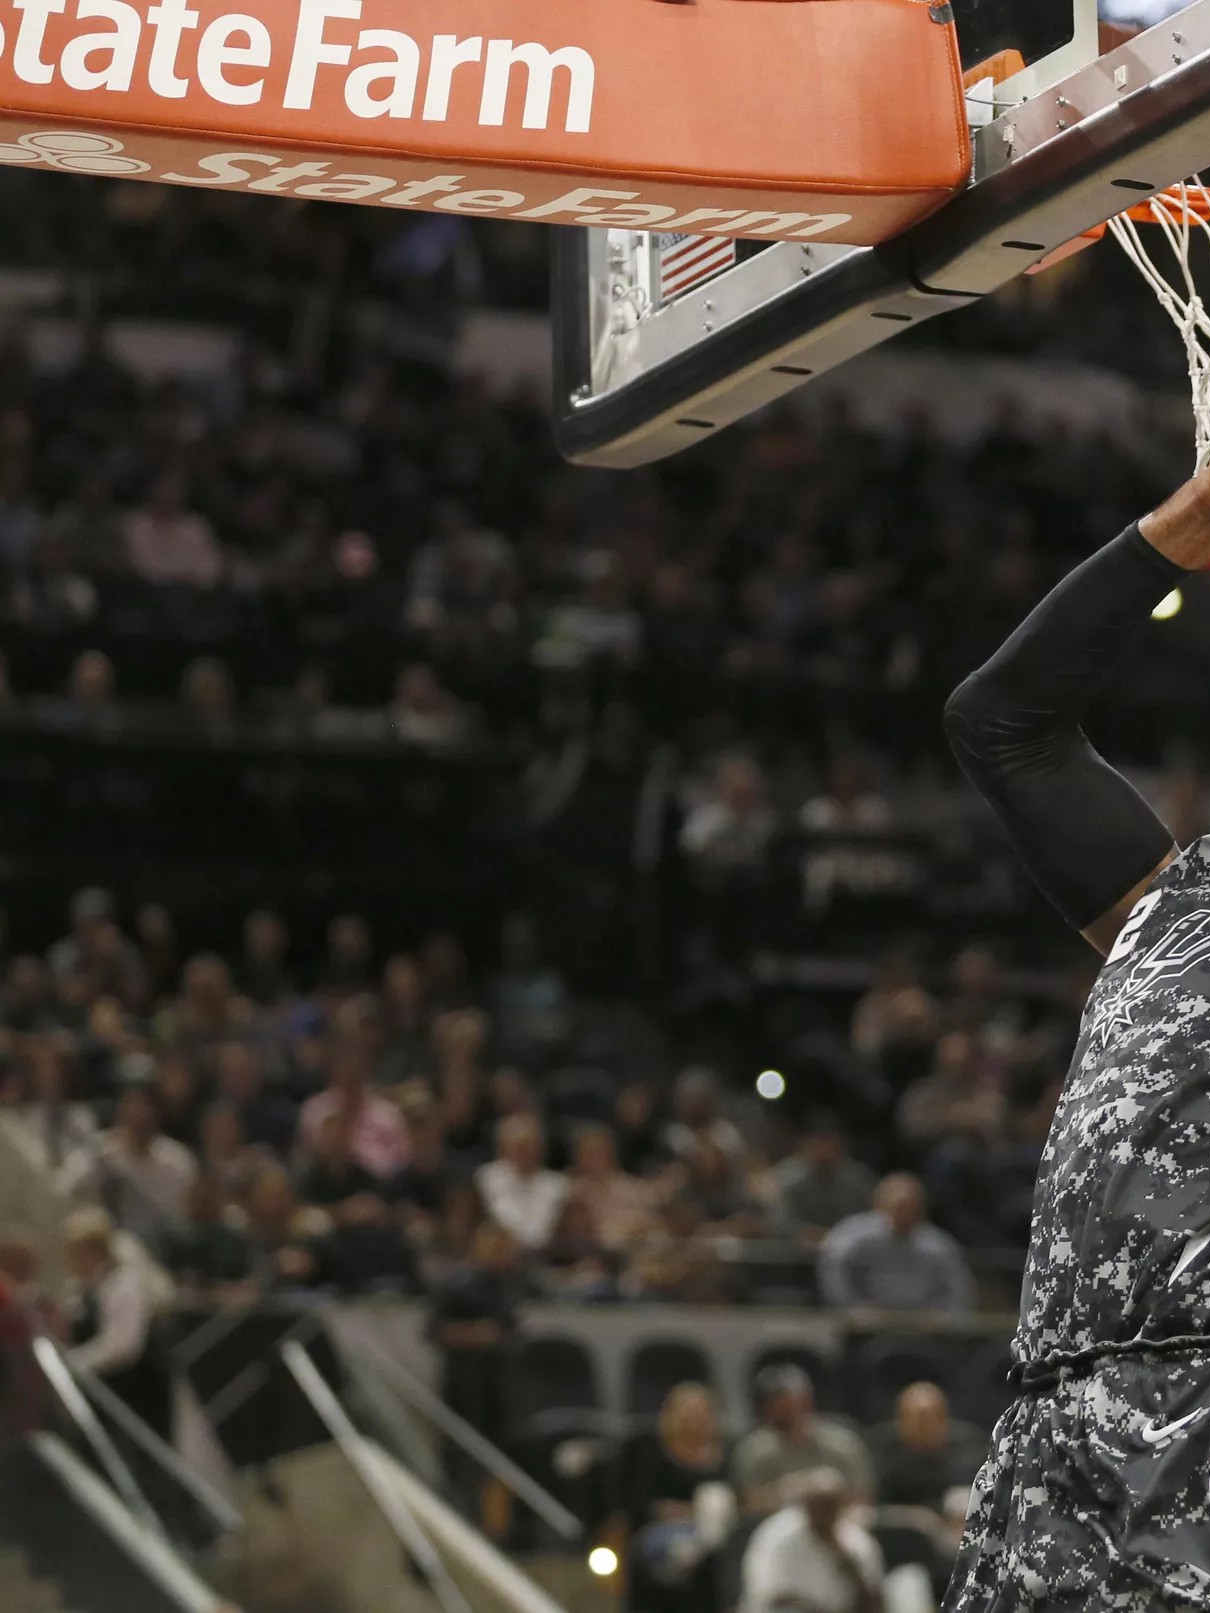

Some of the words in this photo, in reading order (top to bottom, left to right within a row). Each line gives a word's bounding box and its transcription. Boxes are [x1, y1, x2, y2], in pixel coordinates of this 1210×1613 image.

[0, 0, 595, 133] tateFarm
[160, 152, 525, 213] State
[509, 187, 853, 236] Farm
